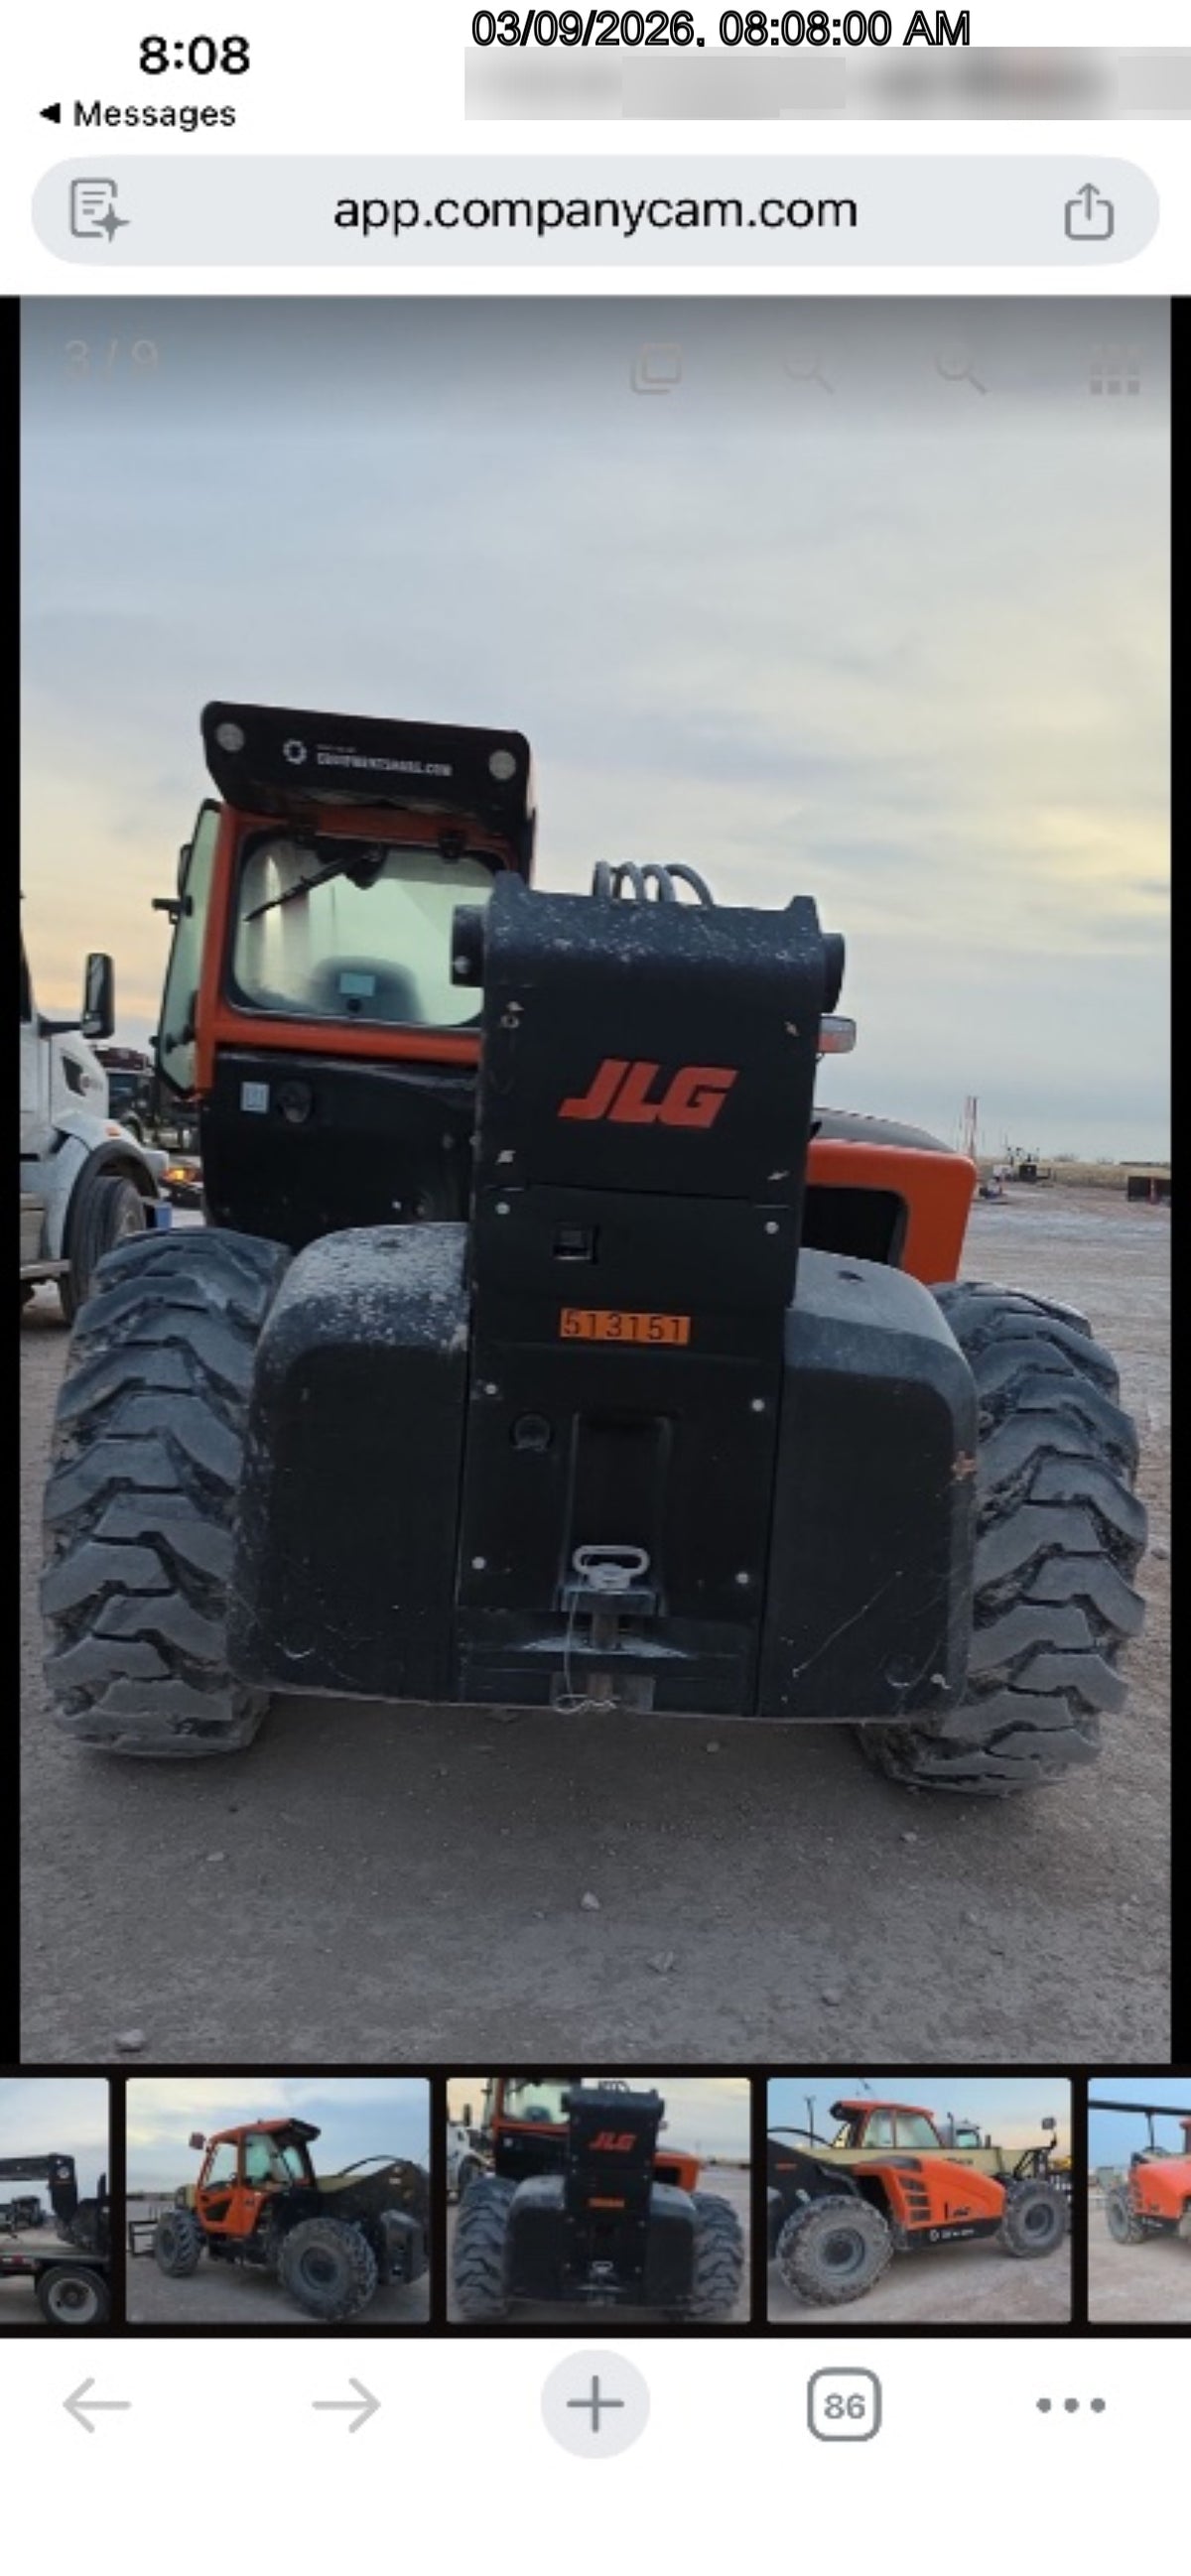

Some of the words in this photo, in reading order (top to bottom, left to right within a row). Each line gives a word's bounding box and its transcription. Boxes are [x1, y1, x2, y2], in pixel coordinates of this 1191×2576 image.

[139, 35, 250, 75] 8:08
[73, 100, 236, 133] Messages
[333, 198, 858, 238] app.companycam.com
[557, 1057, 739, 1129] JLG
[563, 1310, 684, 1341] 513151
[824, 2392, 865, 2419] 86
